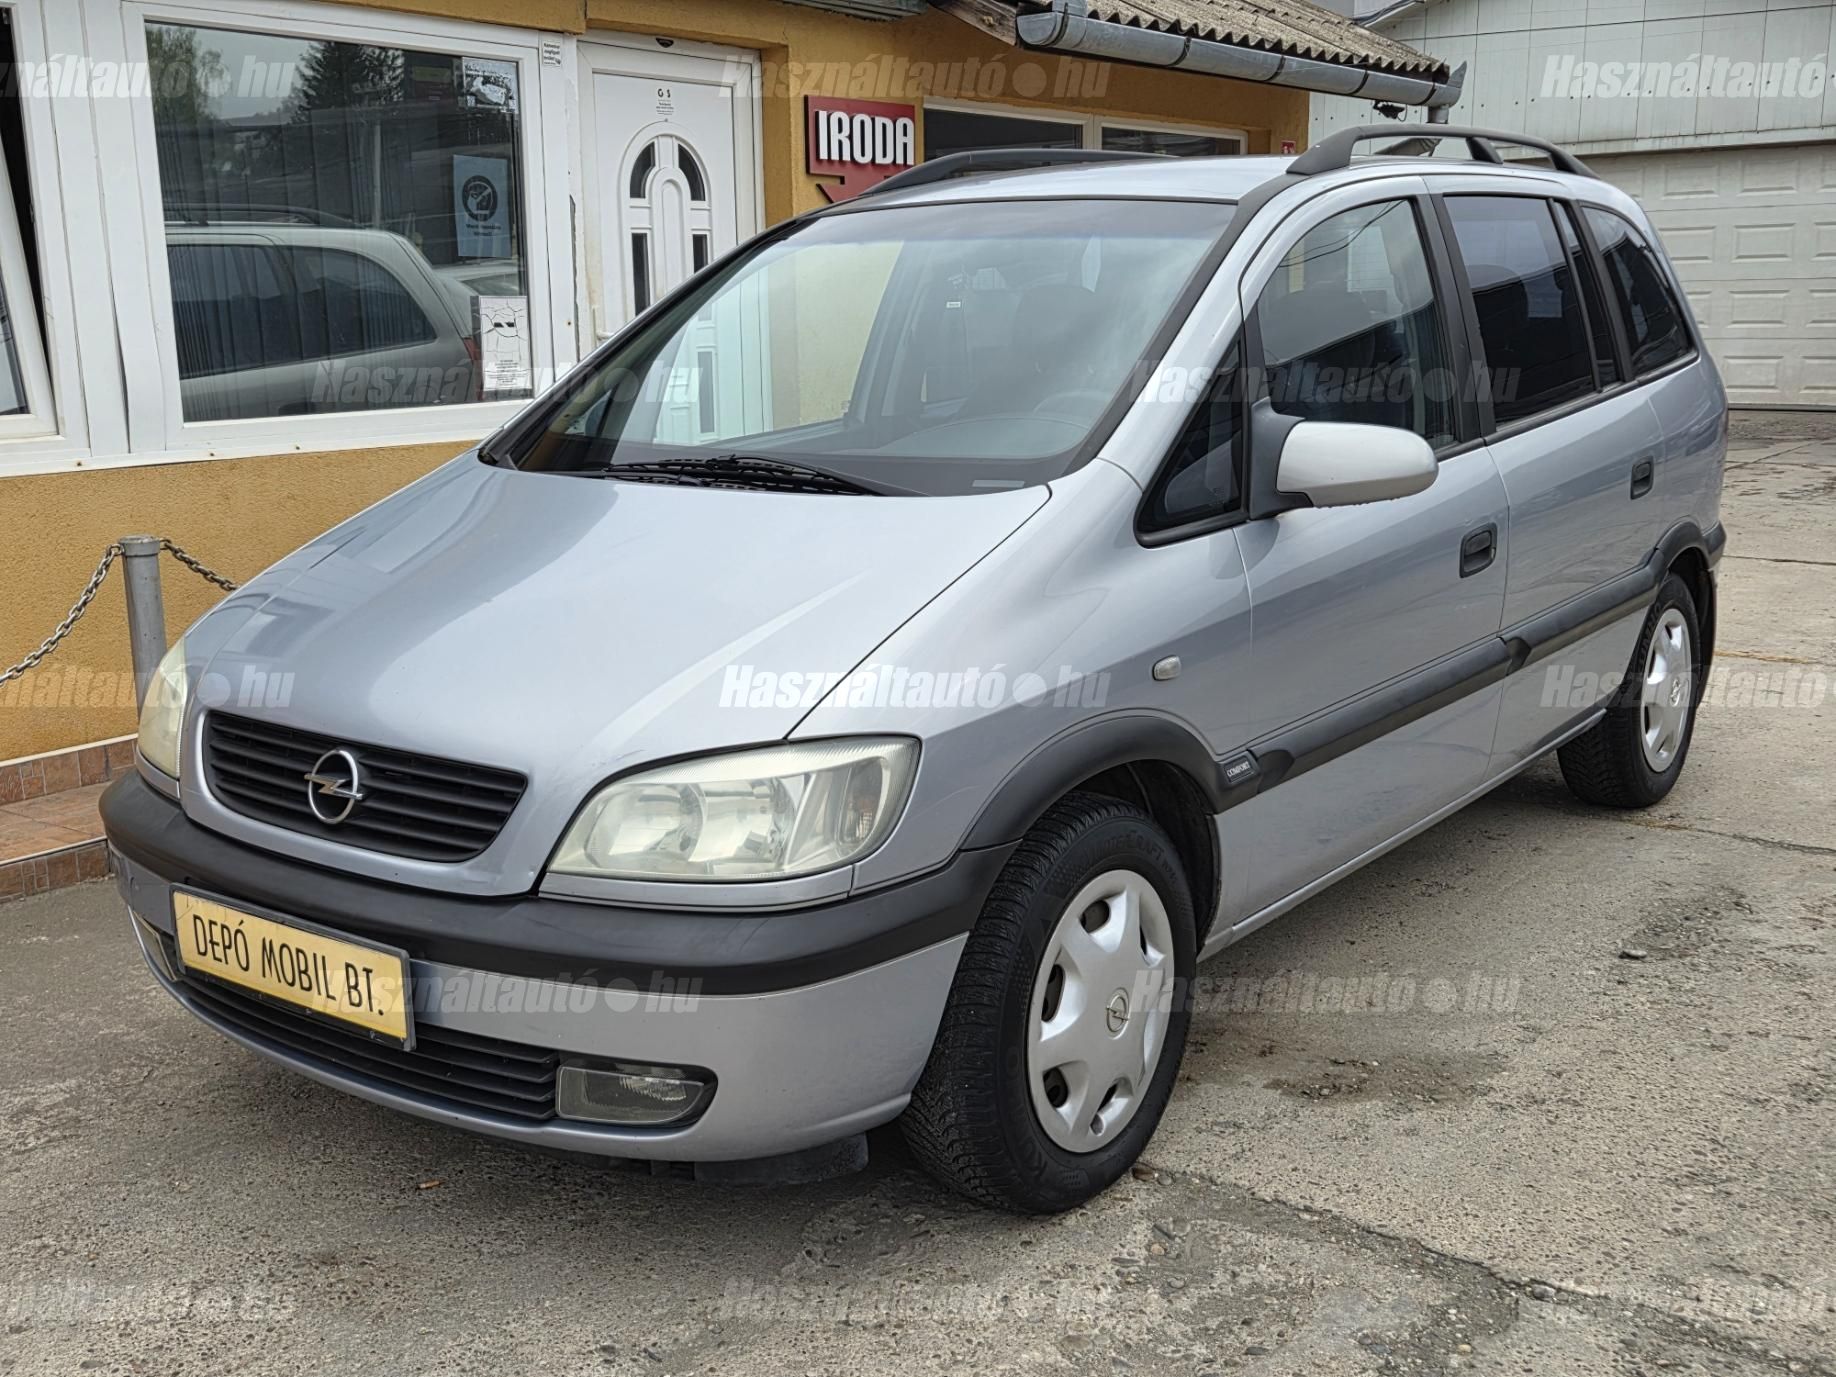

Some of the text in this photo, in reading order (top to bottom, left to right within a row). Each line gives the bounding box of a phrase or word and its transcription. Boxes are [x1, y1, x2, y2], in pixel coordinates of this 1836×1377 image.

[817, 110, 915, 166] IRODA
[193, 914, 385, 1016] DEPÓ MOBIL BT.
